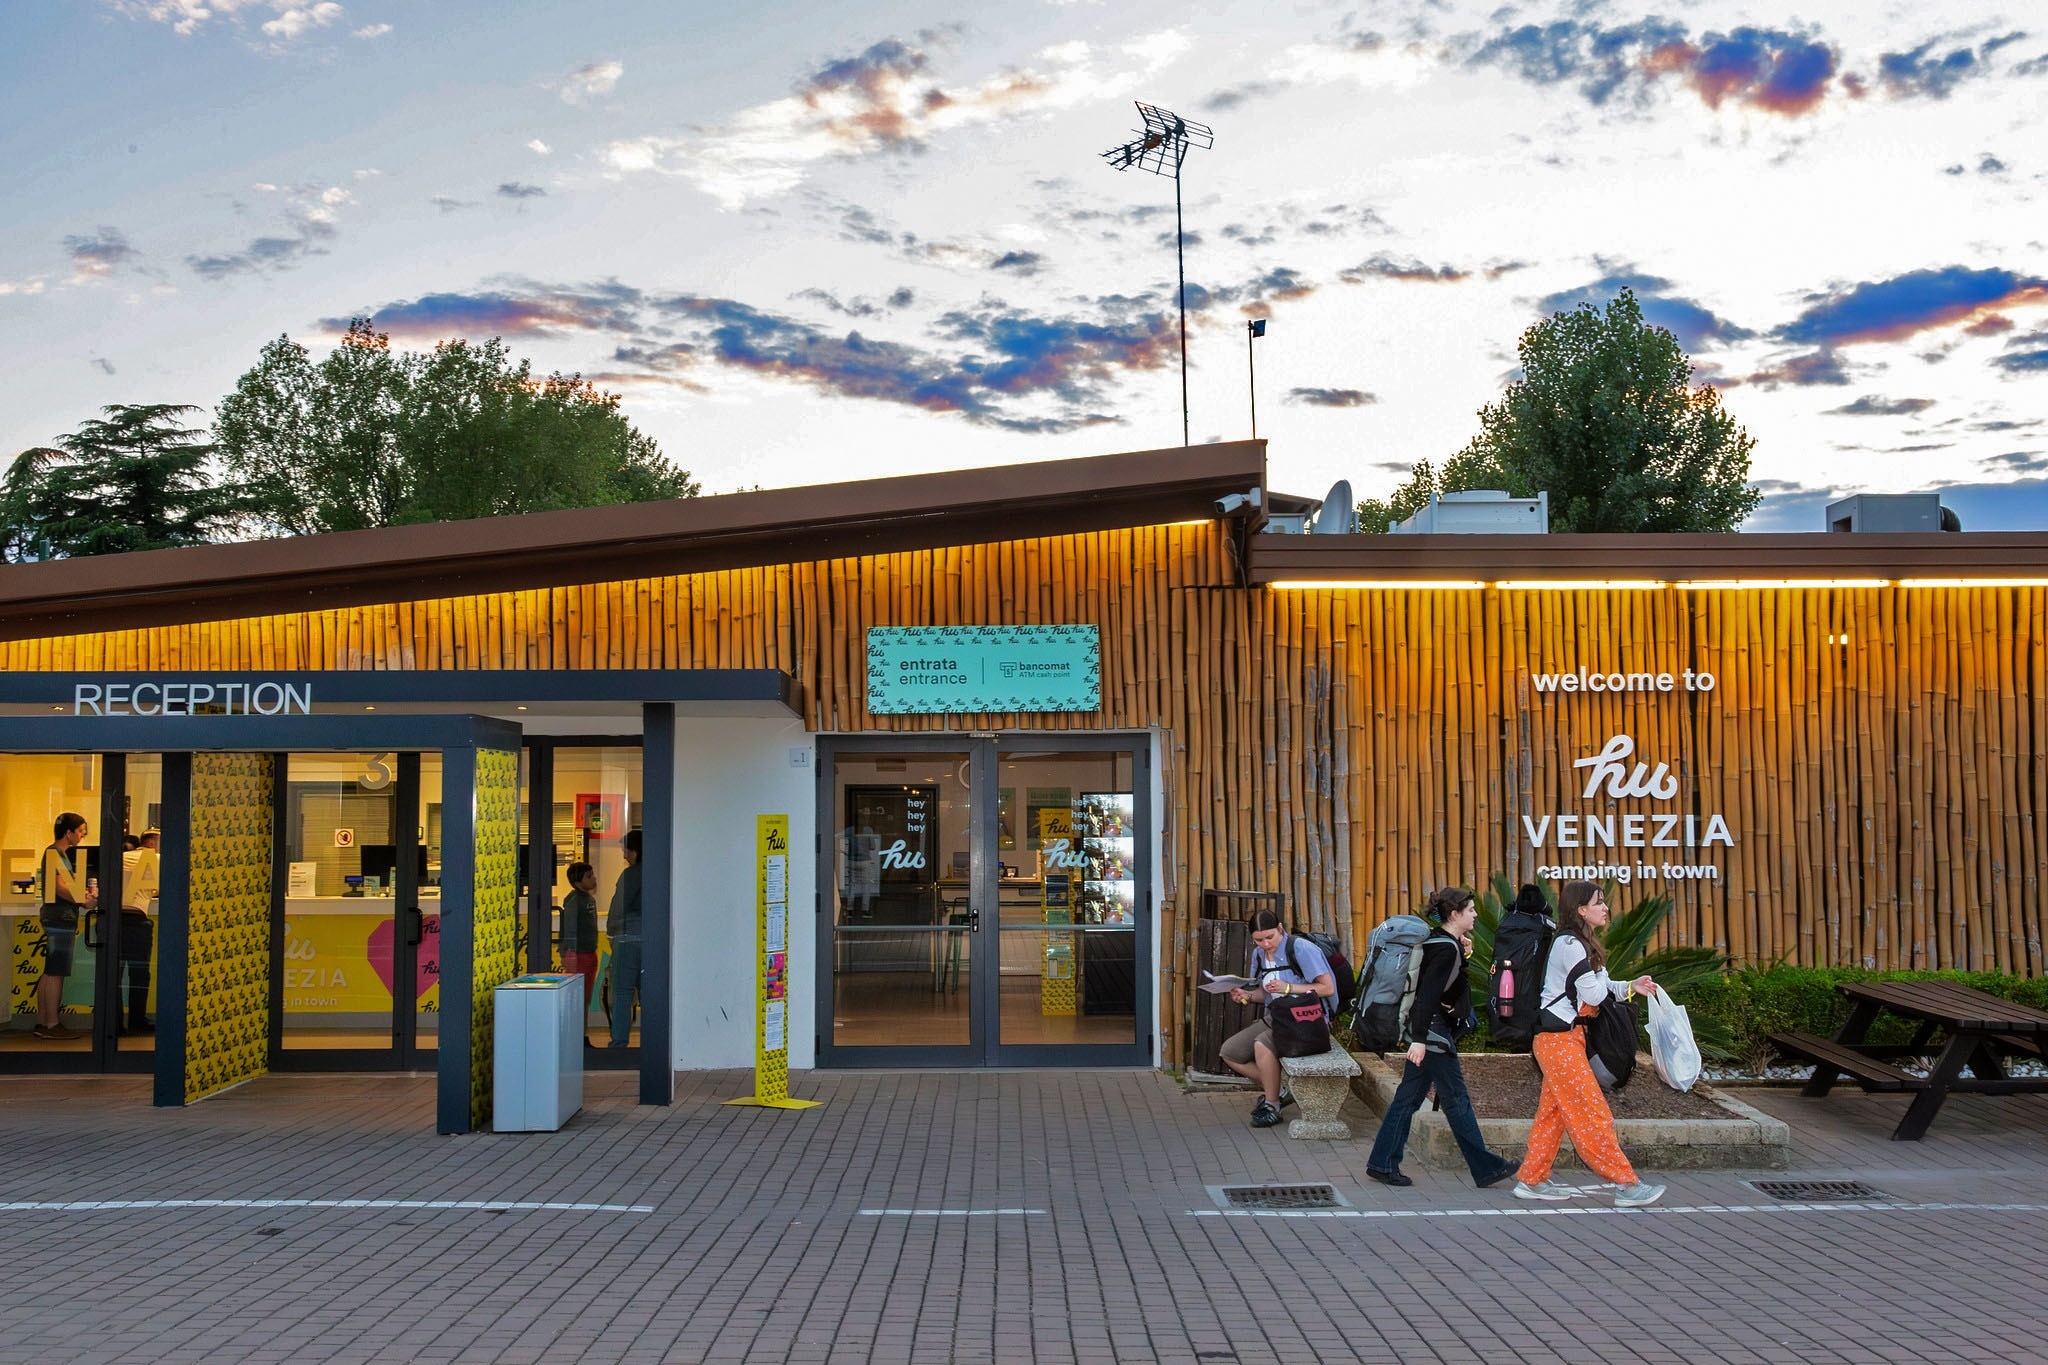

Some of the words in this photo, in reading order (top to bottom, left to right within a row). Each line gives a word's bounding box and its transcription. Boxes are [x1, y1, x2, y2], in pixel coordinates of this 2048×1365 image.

[1088, 625, 1099, 634] h
[1088, 642, 1099, 654] h
[900, 658, 957, 670] entrata
[1019, 662, 1070, 670] bancomat
[1088, 662, 1099, 674] h
[900, 673, 967, 685] entrance
[1532, 666, 1674, 692] welcome
[1682, 668, 1715, 691] to
[1088, 683, 1099, 695] h
[74, 682, 311, 716] RECEPTION
[1573, 735, 1678, 800] hu
[908, 799, 925, 809] hey
[908, 811, 925, 821] hey
[1072, 809, 1088, 820] hey
[908, 823, 925, 833] hey
[1045, 818, 1069, 833] hu
[1072, 821, 1088, 832] hey
[1522, 815, 1735, 848] VENEZIA
[766, 829, 785, 850] hu
[878, 840, 926, 869] hu
[1042, 838, 1090, 868] hu
[1537, 860, 1630, 883] camping
[1636, 860, 1656, 879] in
[1662, 862, 1717, 880] town
[17, 920, 40, 934] hu
[28, 934, 47, 957] h
[16, 959, 39, 974] hu
[285, 968, 348, 988] EZIA
[15, 1001, 38, 1014] hu
[305, 997, 338, 1006] town
